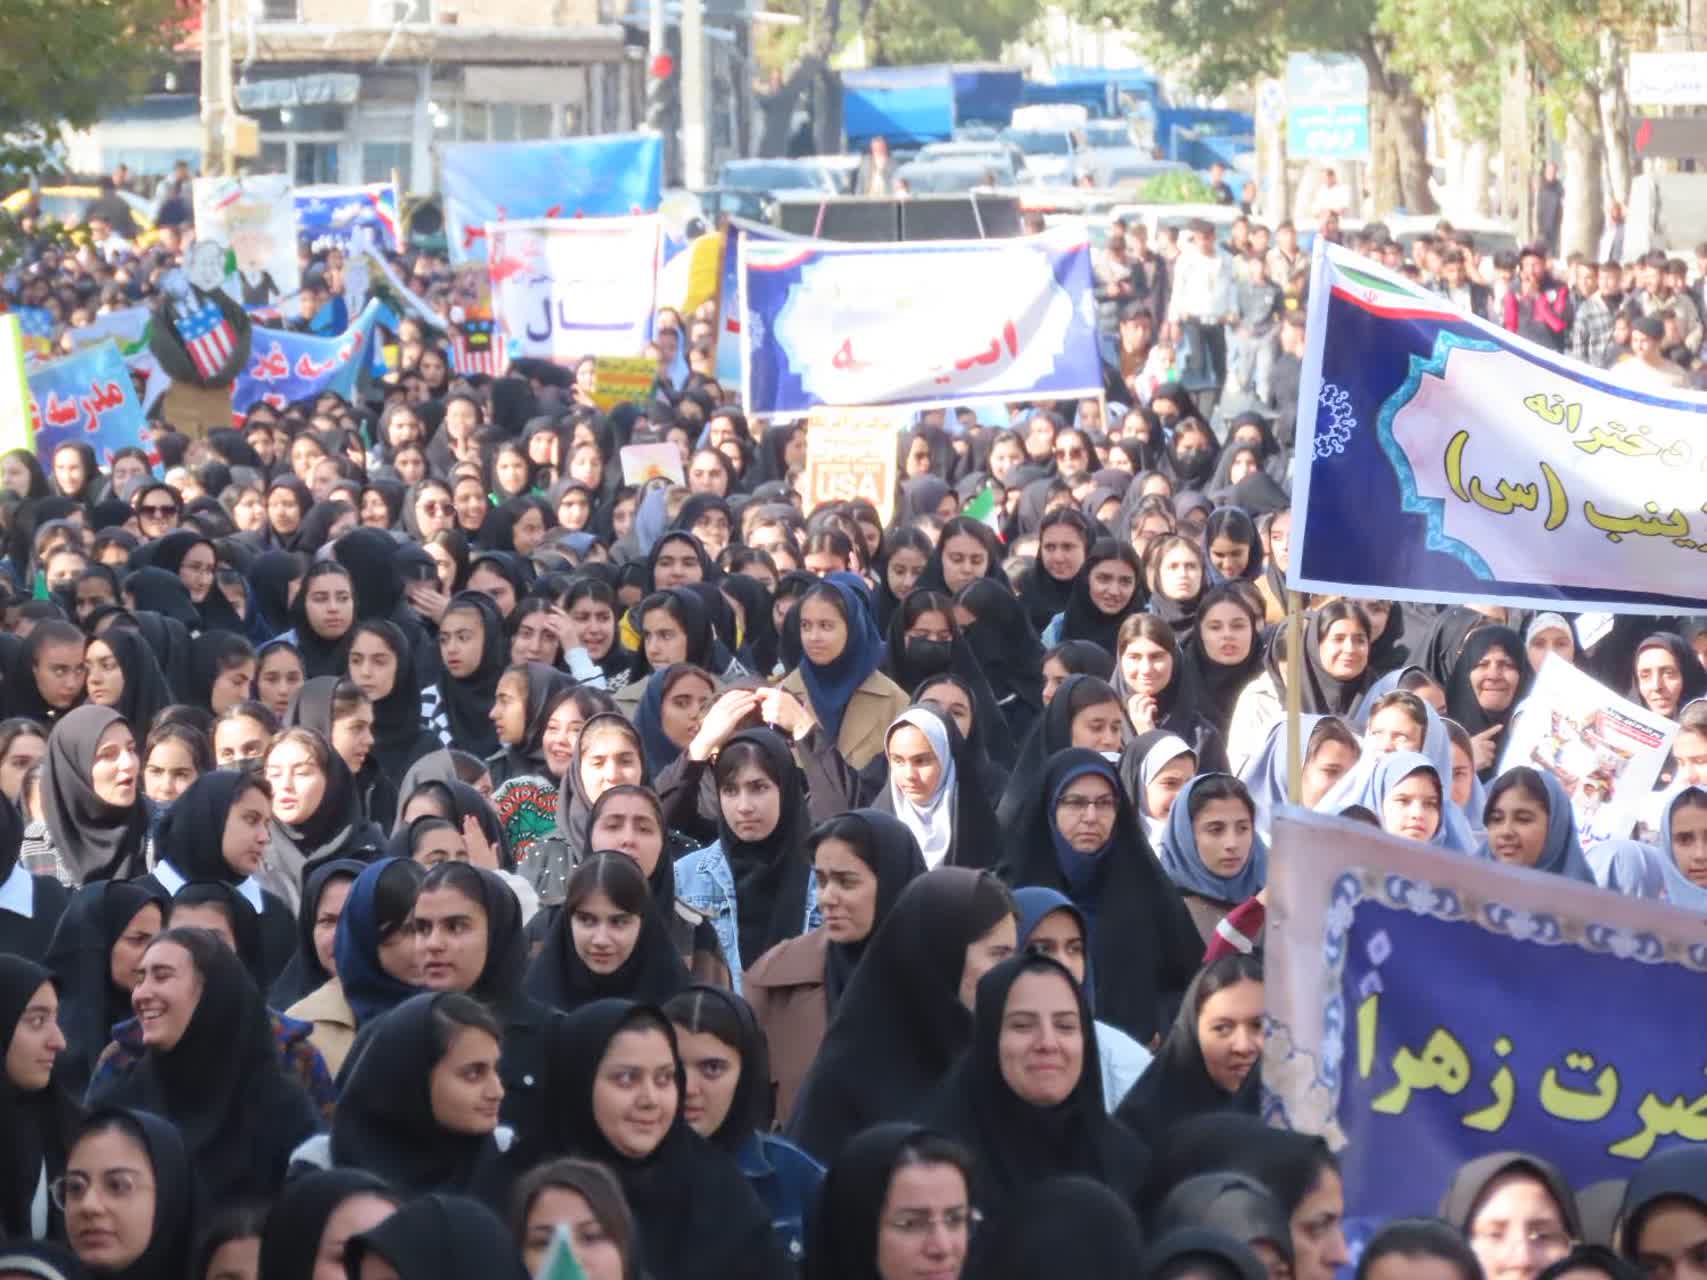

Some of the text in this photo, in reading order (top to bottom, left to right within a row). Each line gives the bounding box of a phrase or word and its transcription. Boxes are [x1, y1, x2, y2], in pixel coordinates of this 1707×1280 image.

[817, 471, 882, 502] USA
[1444, 430, 1569, 532] (س)
[1356, 992, 1516, 1133] زهرا
